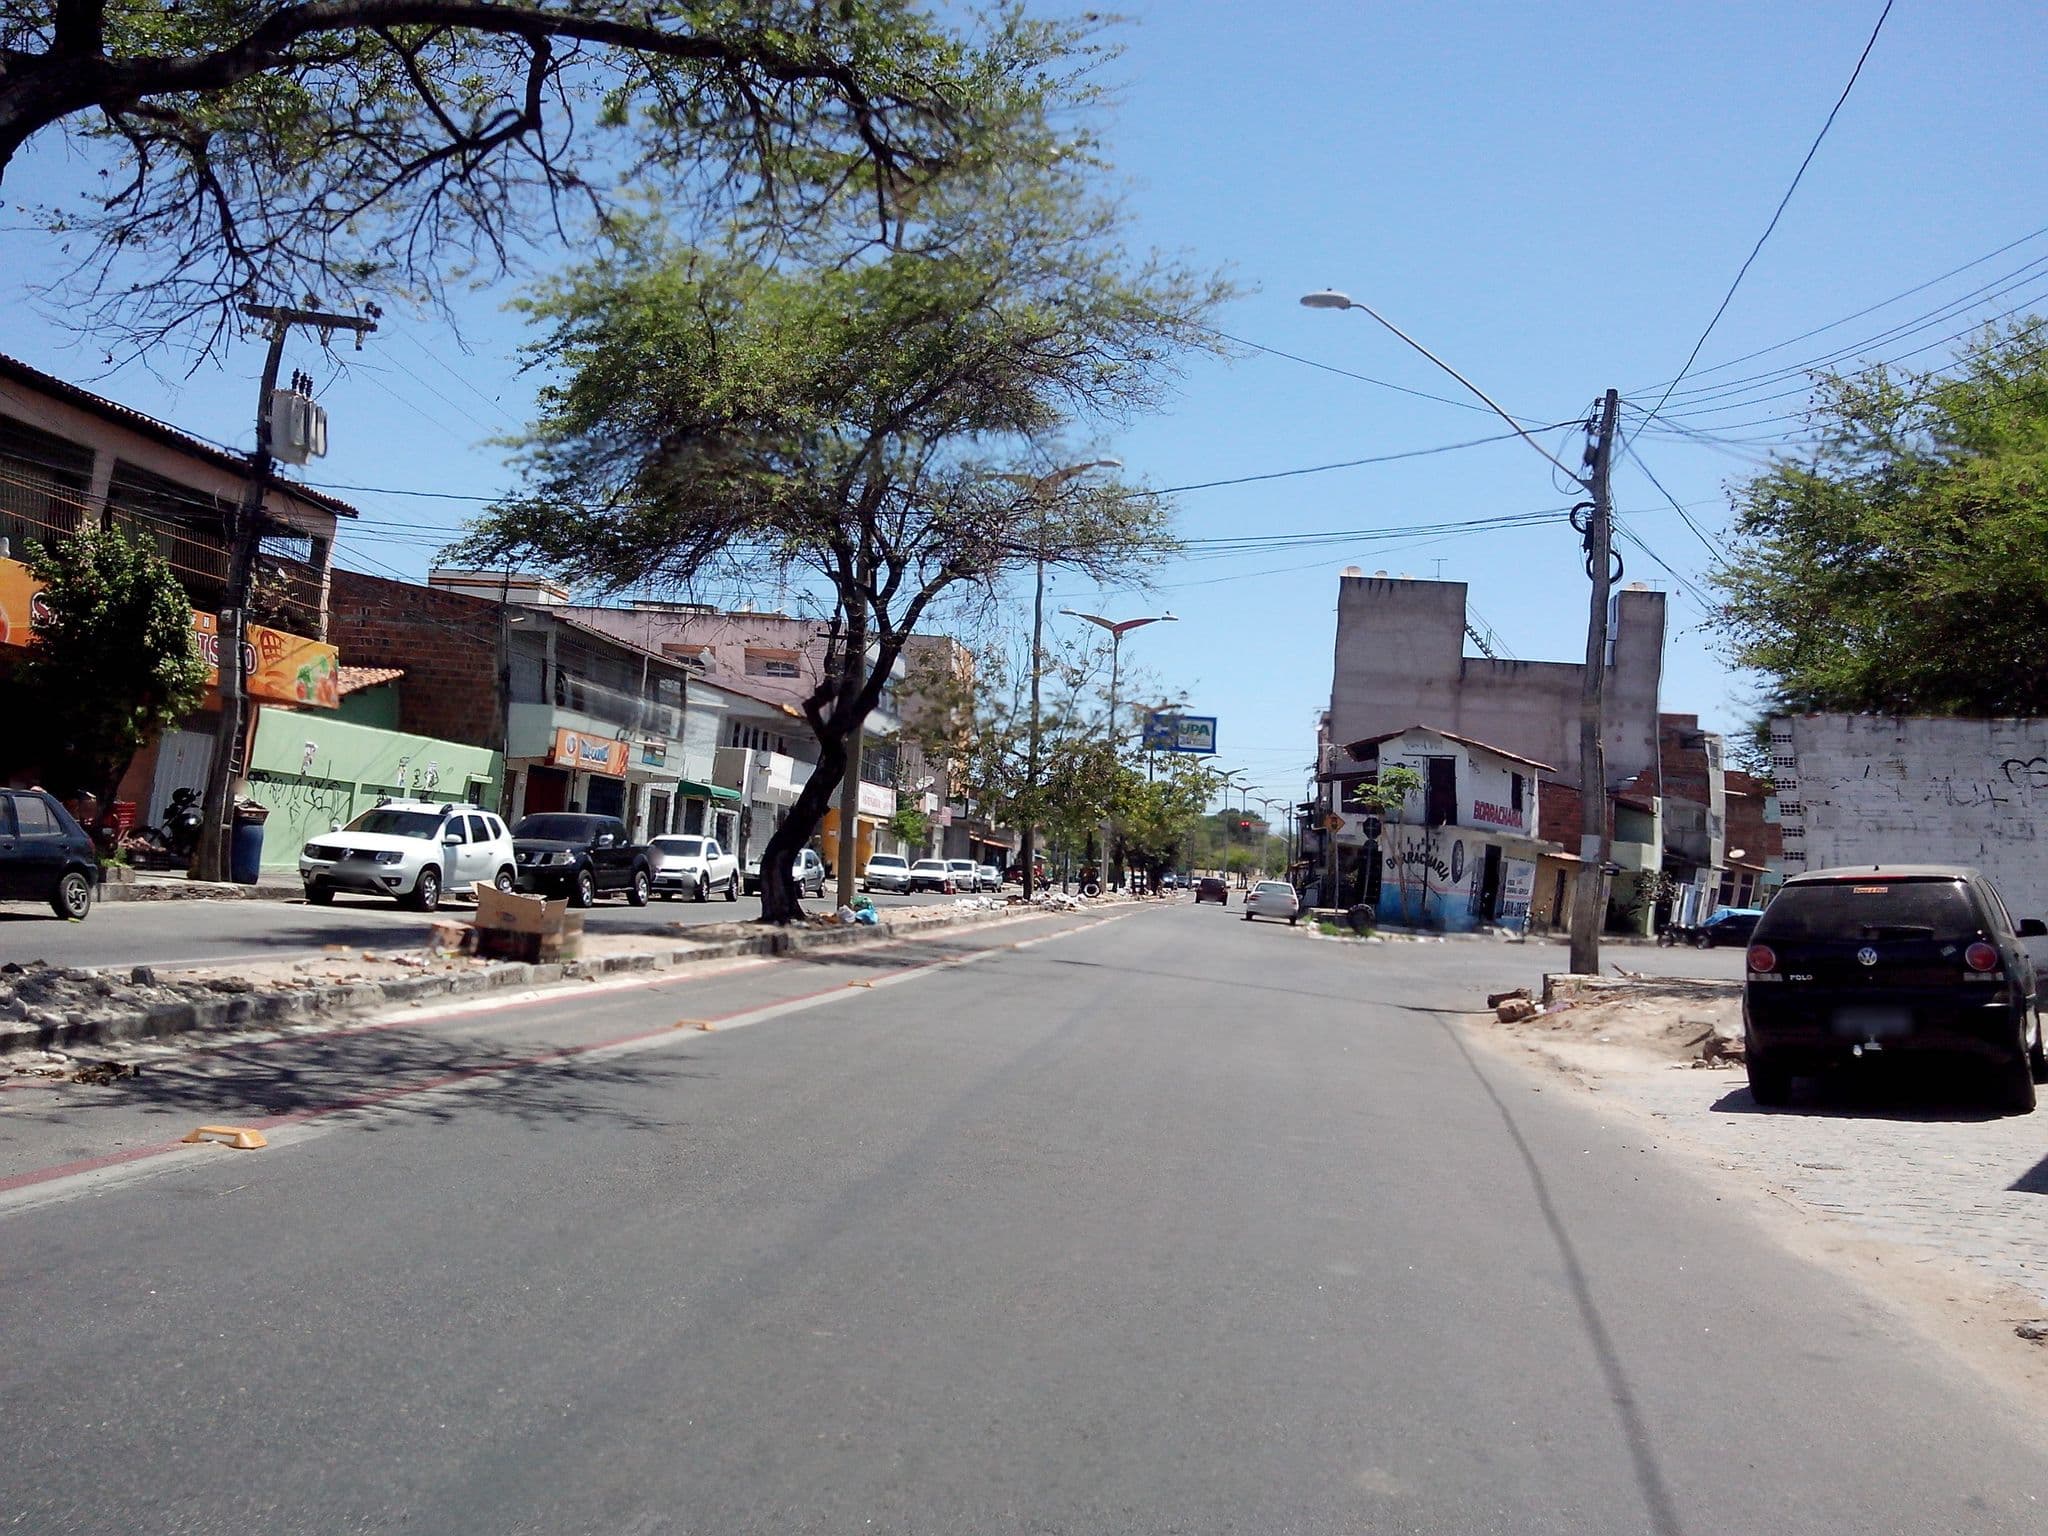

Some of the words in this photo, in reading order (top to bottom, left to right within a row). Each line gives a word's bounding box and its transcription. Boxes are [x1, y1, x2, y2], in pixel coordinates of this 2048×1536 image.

[1180, 723, 1211, 737] UPA
[1472, 800, 1523, 829] BORRACHARIA
[1385, 850, 1450, 882] BRRACHARIA
